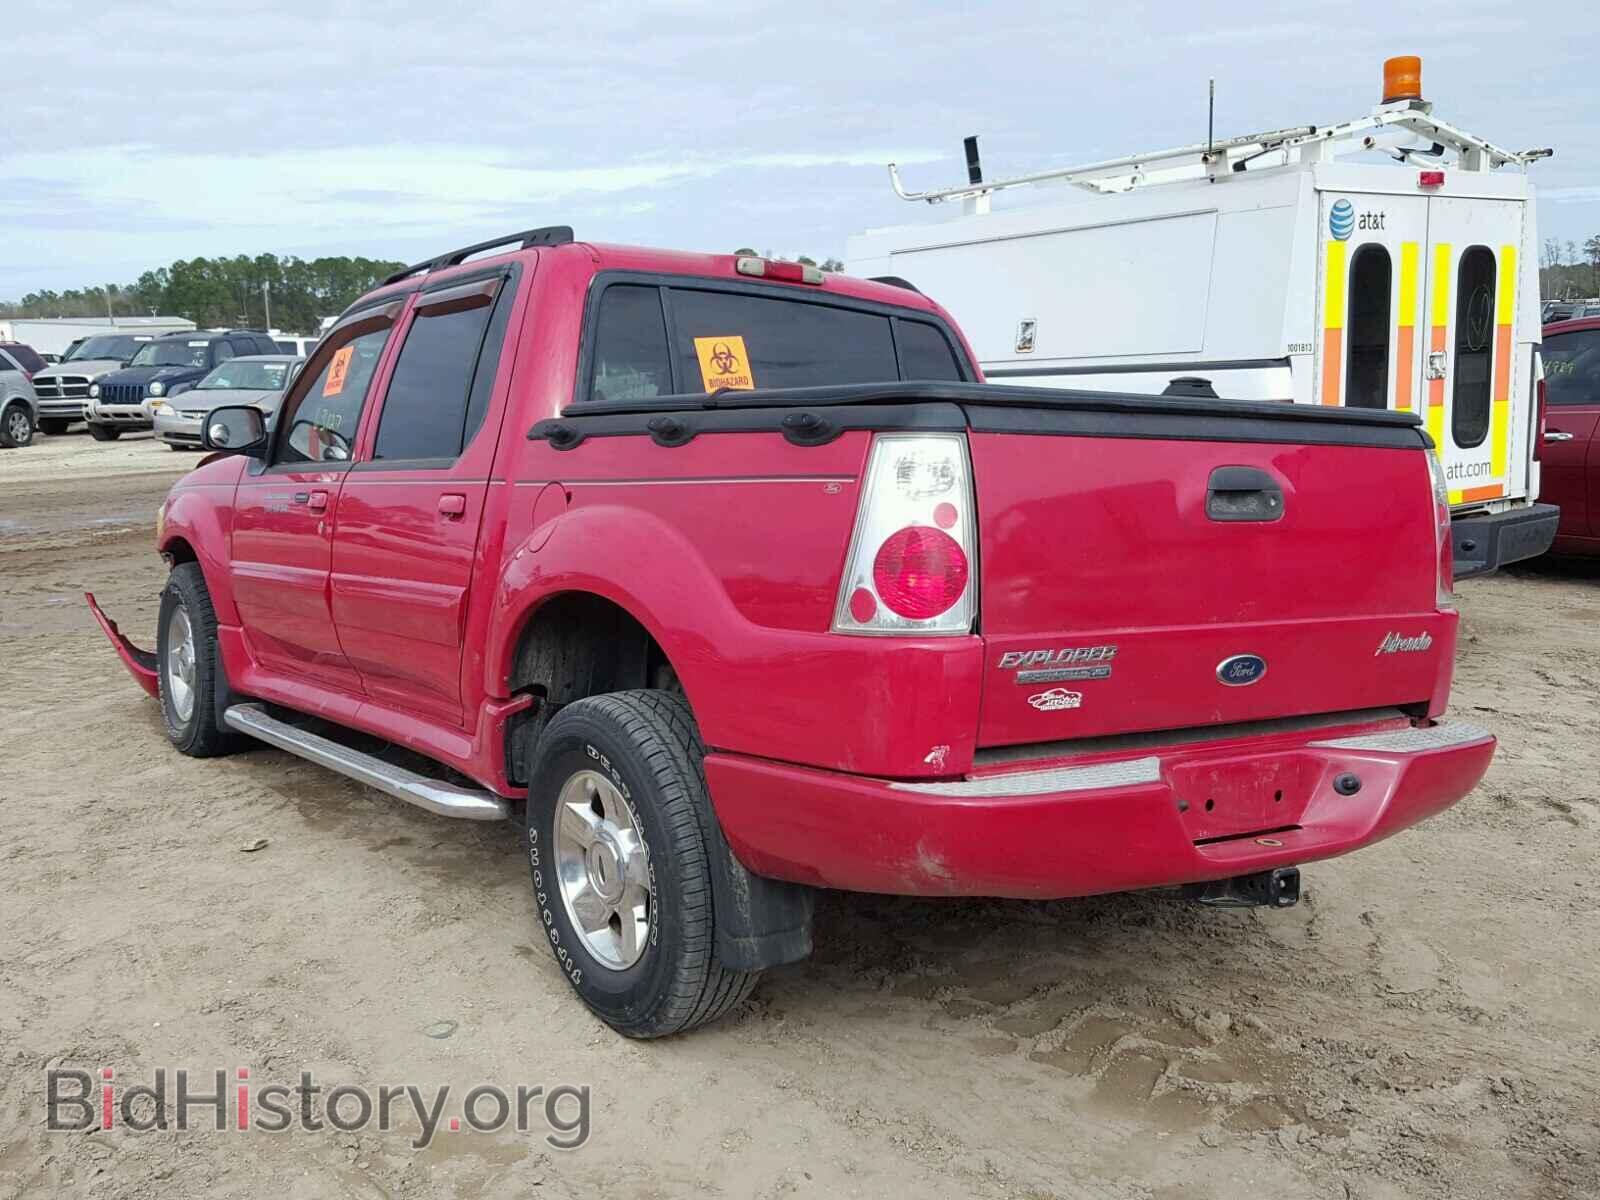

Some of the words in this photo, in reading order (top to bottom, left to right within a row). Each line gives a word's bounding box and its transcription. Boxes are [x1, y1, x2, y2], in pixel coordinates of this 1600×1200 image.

[1359, 210, 1386, 230] at&t
[708, 376, 749, 388] BIOHAZARD
[1446, 462, 1491, 480] att.com
[998, 645, 1118, 668] EXPLORER
